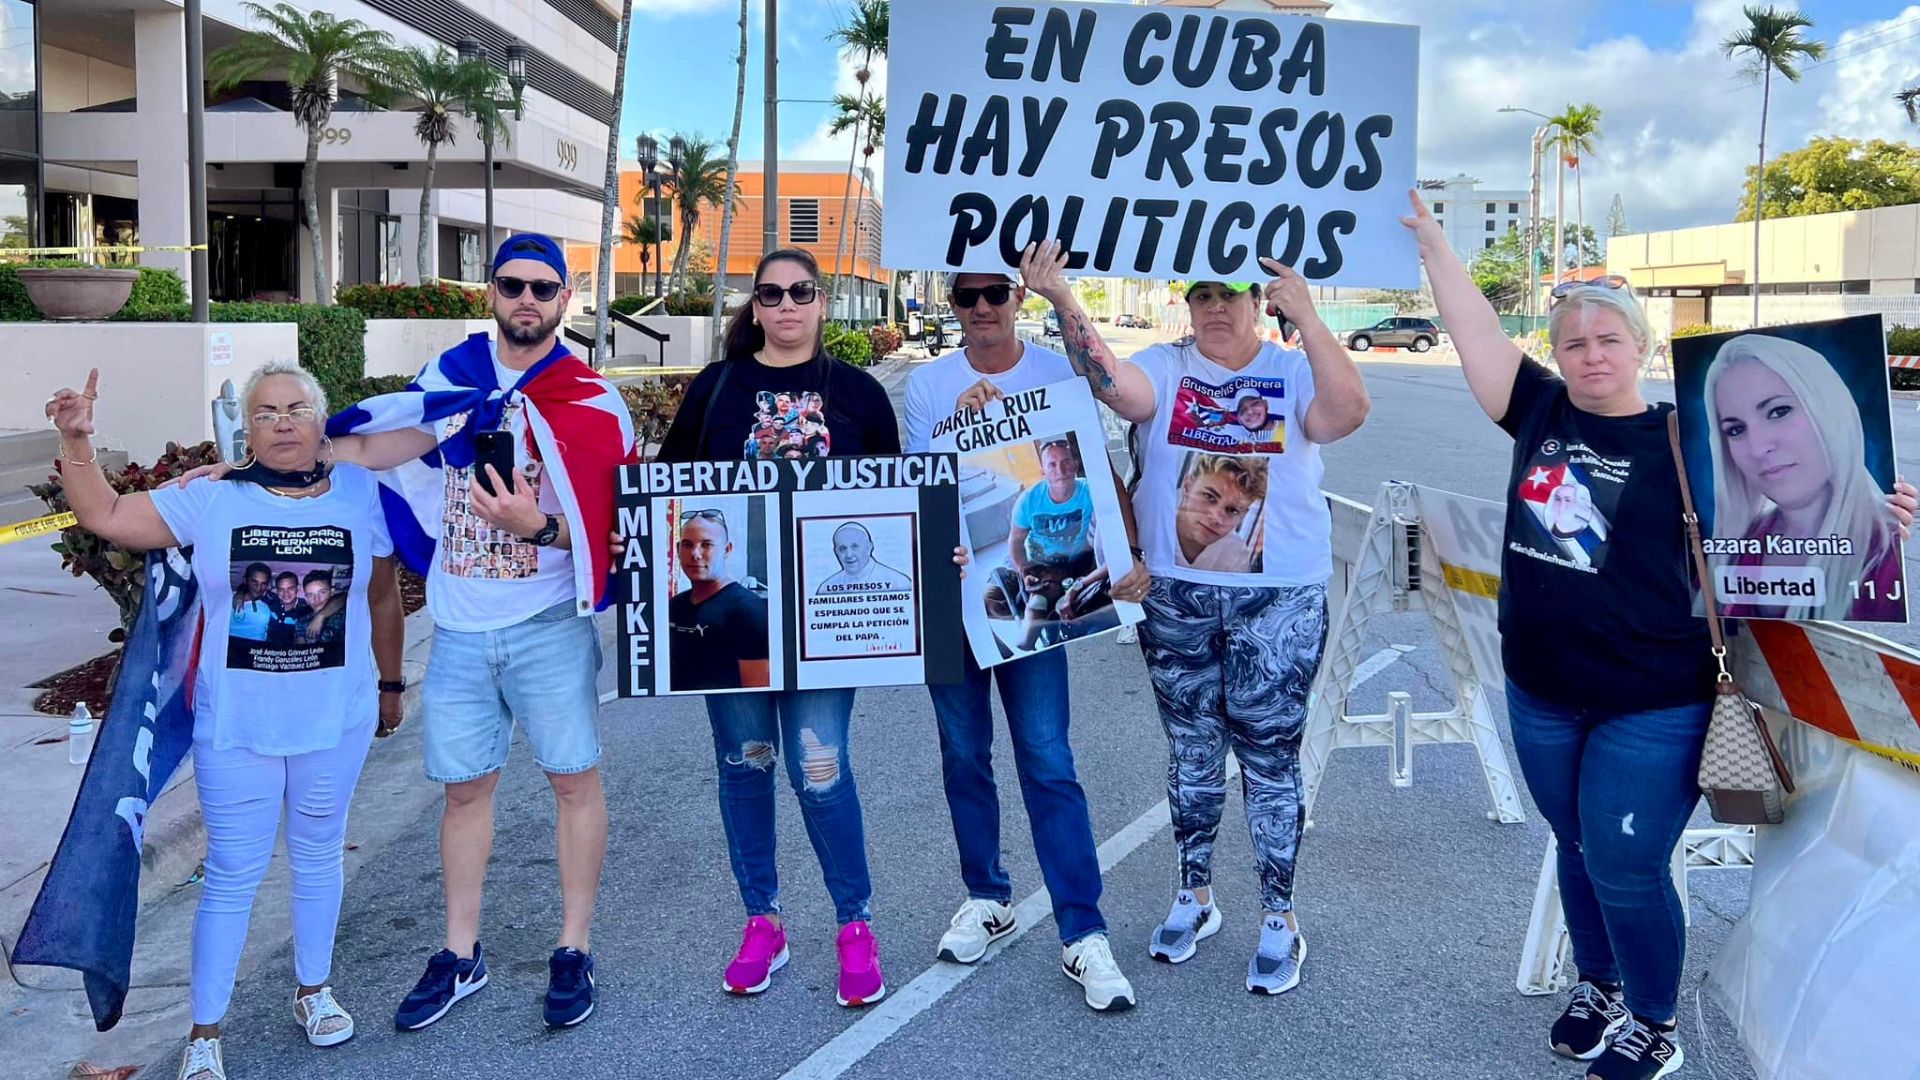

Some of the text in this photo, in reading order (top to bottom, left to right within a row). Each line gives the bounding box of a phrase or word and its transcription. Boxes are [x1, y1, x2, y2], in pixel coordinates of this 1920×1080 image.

[985, 6, 1325, 96] EN CUBA
[905, 92, 1393, 191] HAY PRESOS
[557, 138, 578, 171] 999
[945, 192, 1356, 280] POLITICOS
[1235, 378, 1281, 390] Cabrera
[932, 388, 1050, 439] DARIEL RUIZ
[955, 415, 1032, 452] GARCIA
[619, 455, 956, 495] LIBERTAD Y JUSTICIA
[241, 538, 345, 547] LOS HERMANOS
[242, 529, 344, 539] LIBERTAD PARA
[275, 545, 312, 555] LEÓN
[1701, 533, 1853, 555] azara Karenia
[827, 584, 844, 592] LOS
[847, 582, 882, 591] PRESOS
[1724, 576, 1816, 597] Libertad
[1848, 580, 1876, 600] 11
[618, 506, 649, 696] MAIKEL
[808, 593, 910, 605] FAMILIARES ESTAMOS
[815, 607, 870, 617] ESPERANDO
[872, 607, 891, 615] QUE
[810, 616, 909, 630] CUMPLA LA PETICIÓN
[855, 632, 880, 641] PAPA
[264, 648, 287, 657] Antonio
